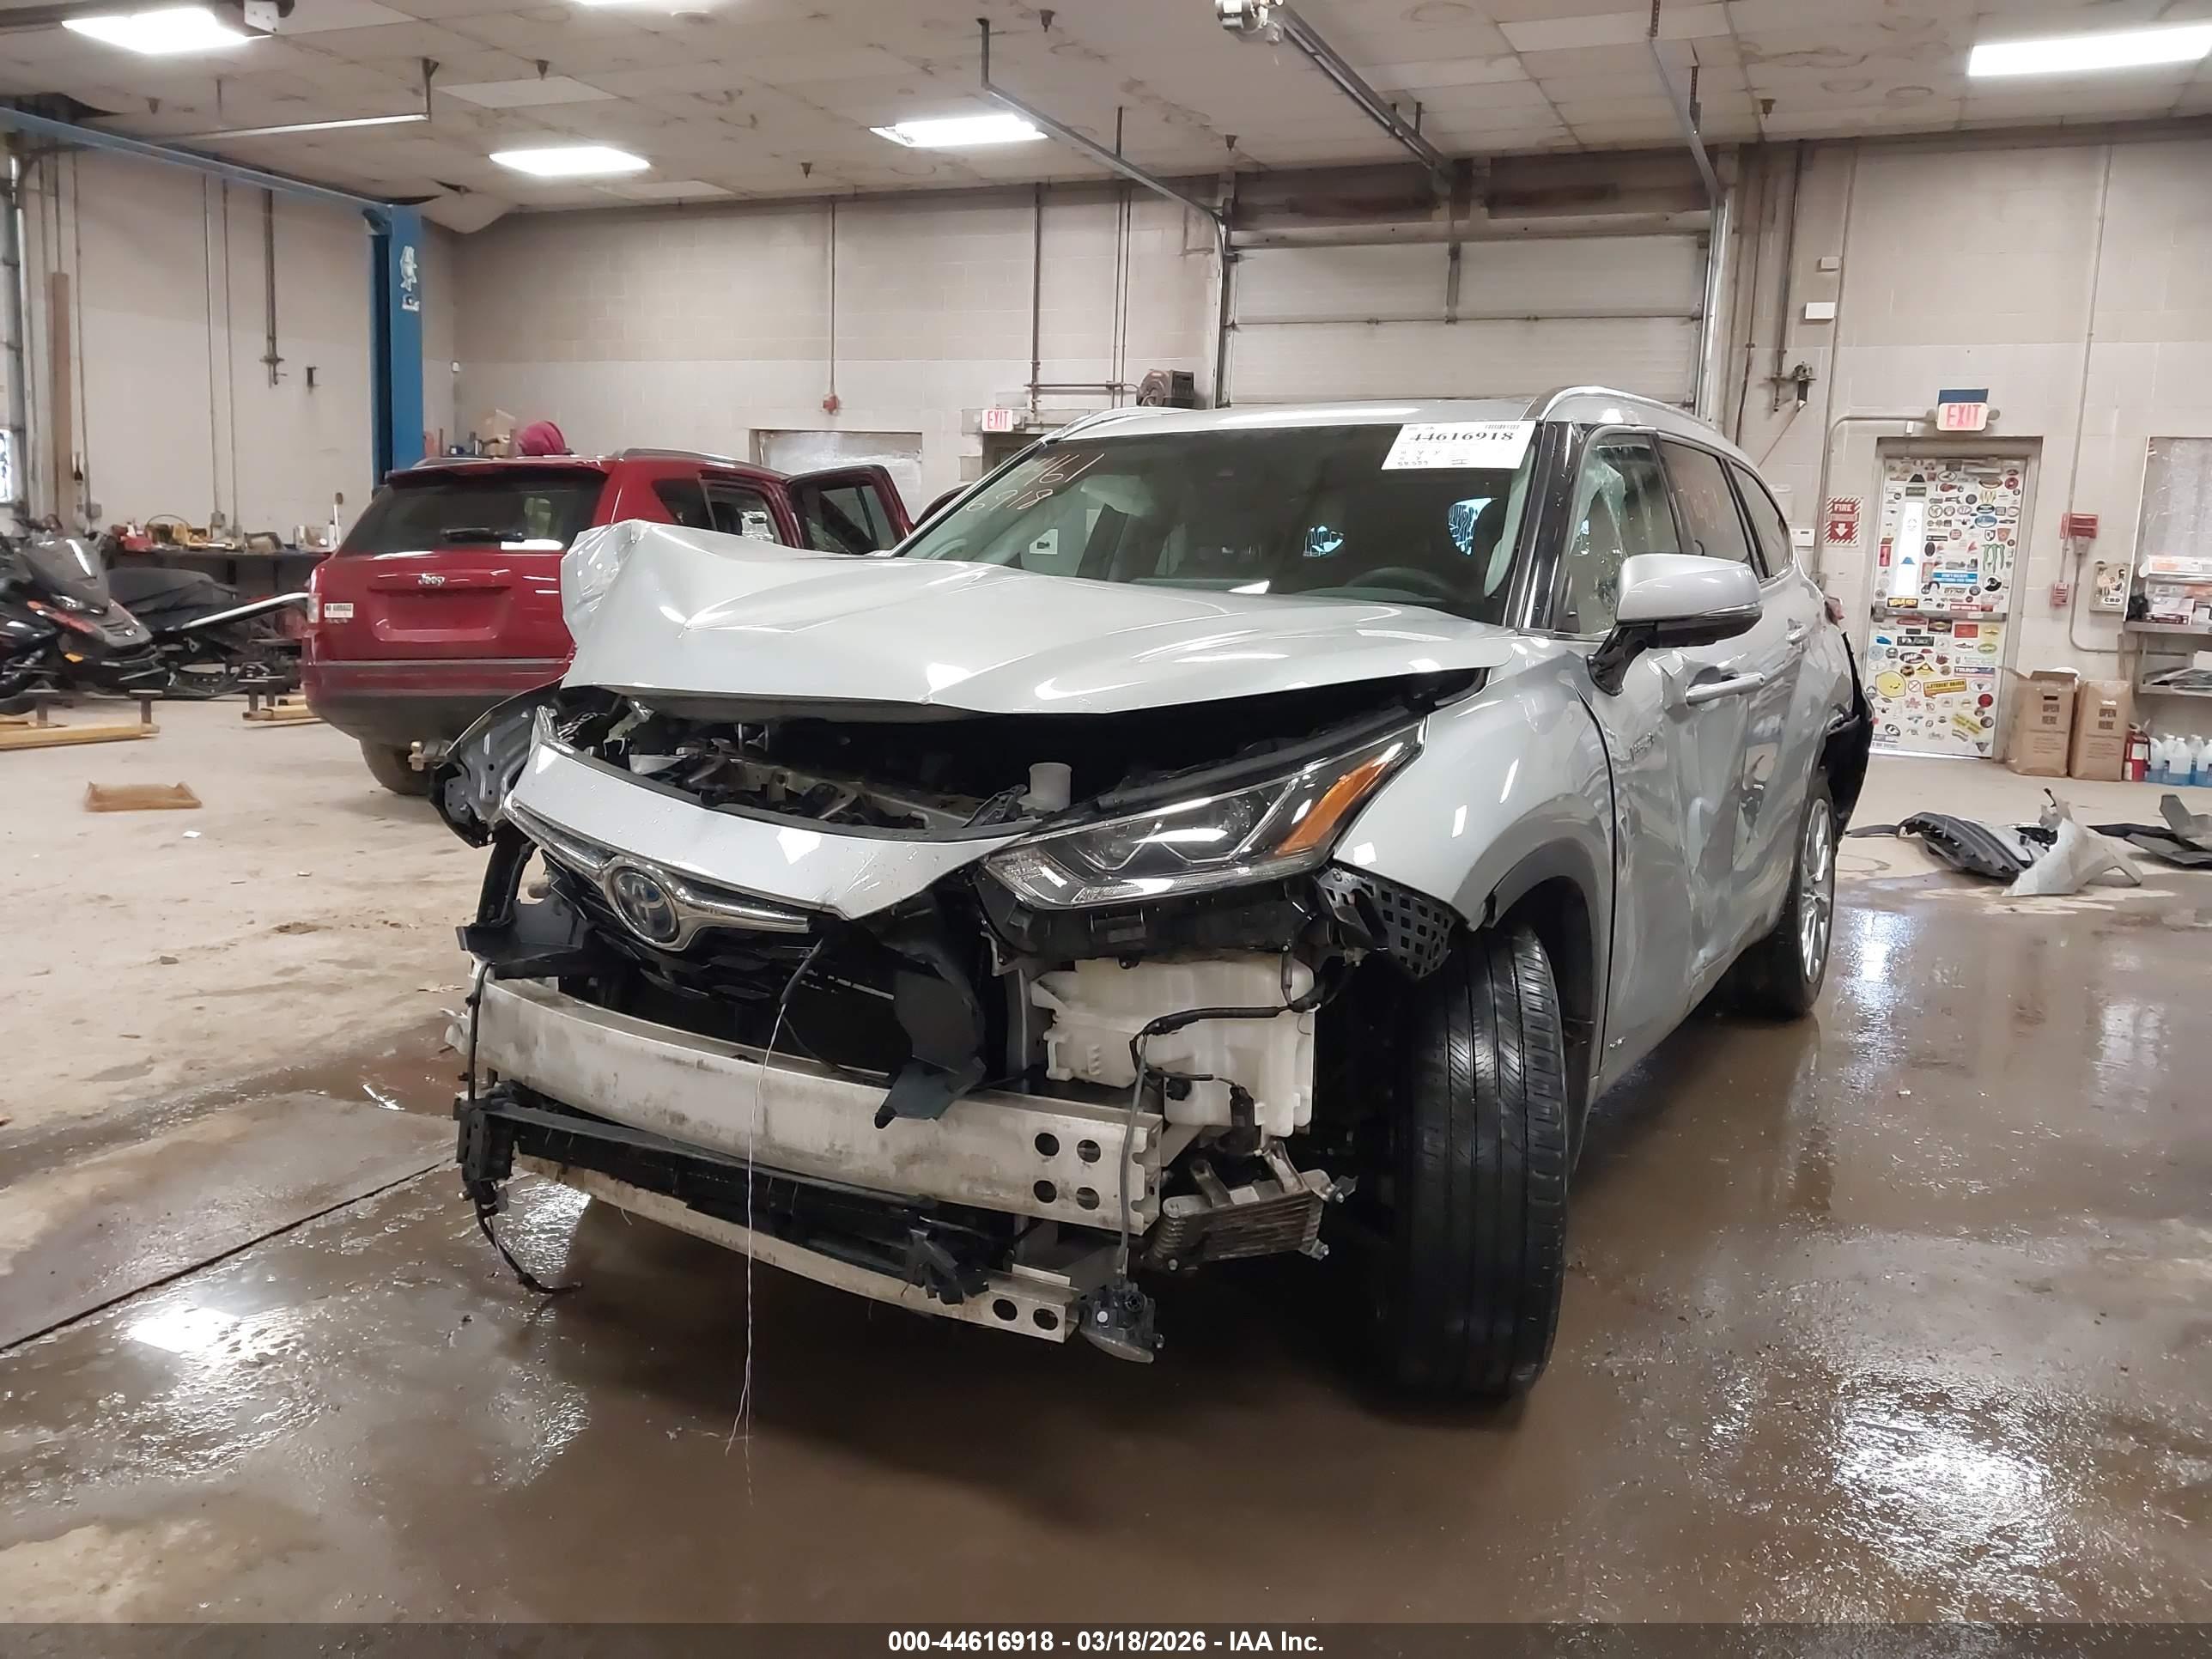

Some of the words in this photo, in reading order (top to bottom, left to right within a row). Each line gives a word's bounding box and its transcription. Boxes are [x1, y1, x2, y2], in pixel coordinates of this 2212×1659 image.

[988, 410, 1009, 429] EXIT
[1946, 404, 1981, 427] EXIT
[1409, 431, 1515, 441] 44616918
[1834, 503, 1852, 512] FIRE
[417, 572, 446, 586] Jeep
[2099, 708, 2117, 718] OPEN
